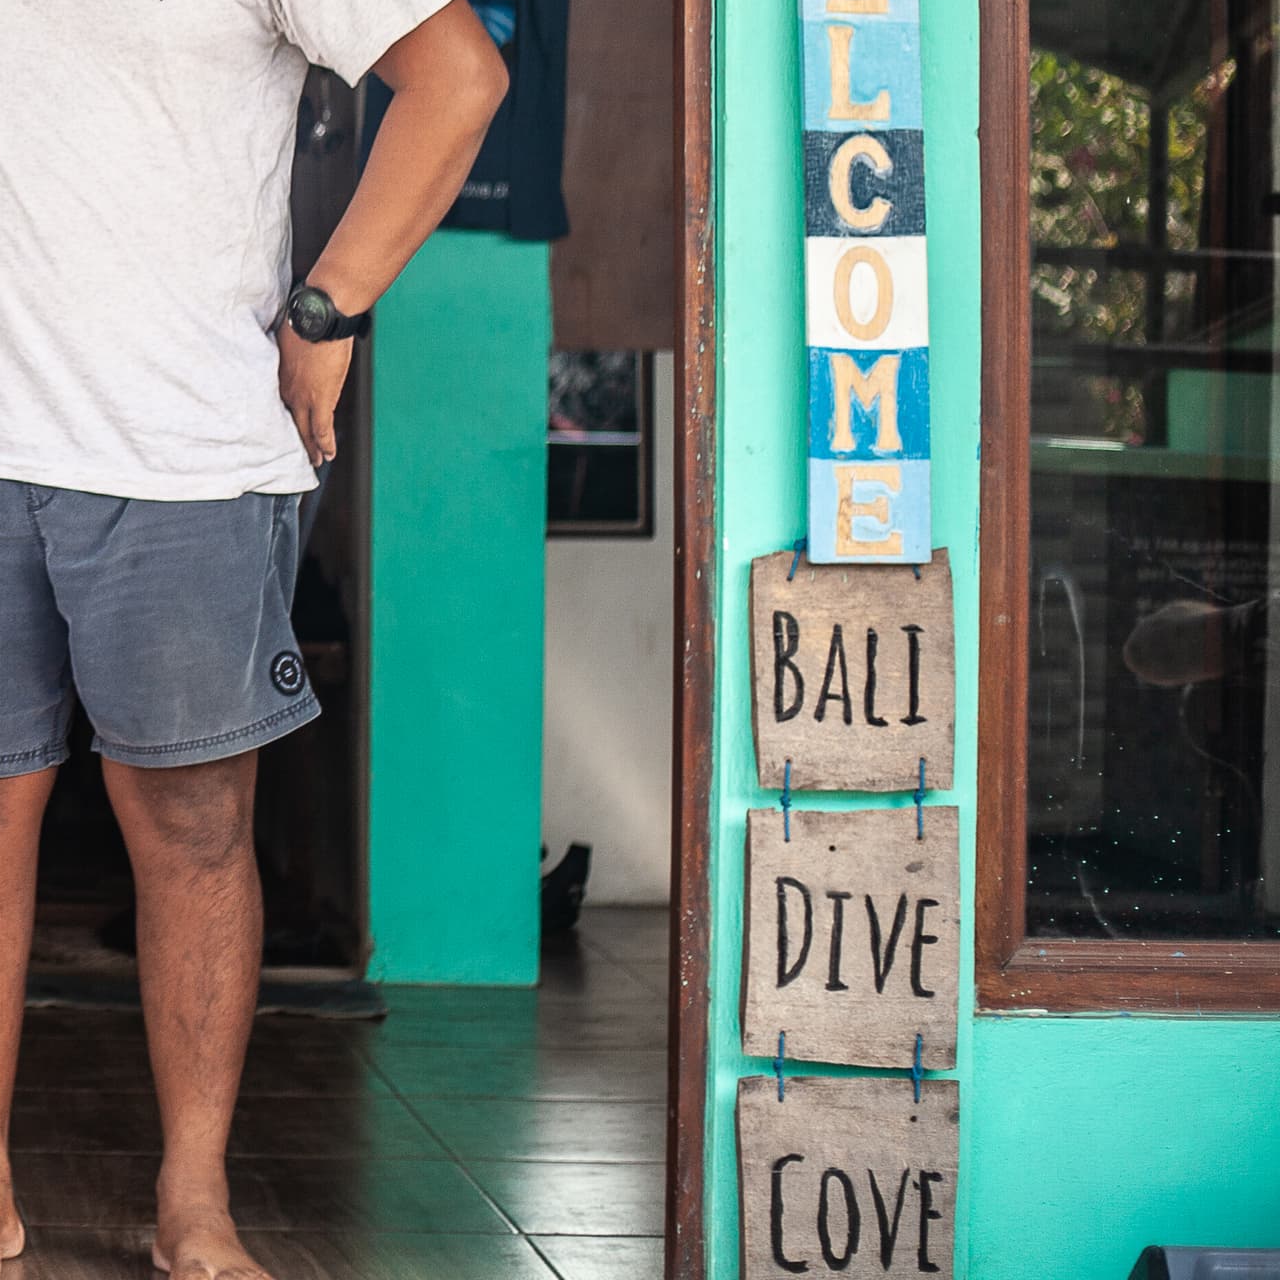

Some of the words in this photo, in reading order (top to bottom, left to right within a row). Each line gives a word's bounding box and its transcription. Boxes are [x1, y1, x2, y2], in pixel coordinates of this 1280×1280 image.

[772, 609, 928, 728] BALI
[774, 876, 940, 999] DIVE
[769, 1152, 944, 1275] COVE
